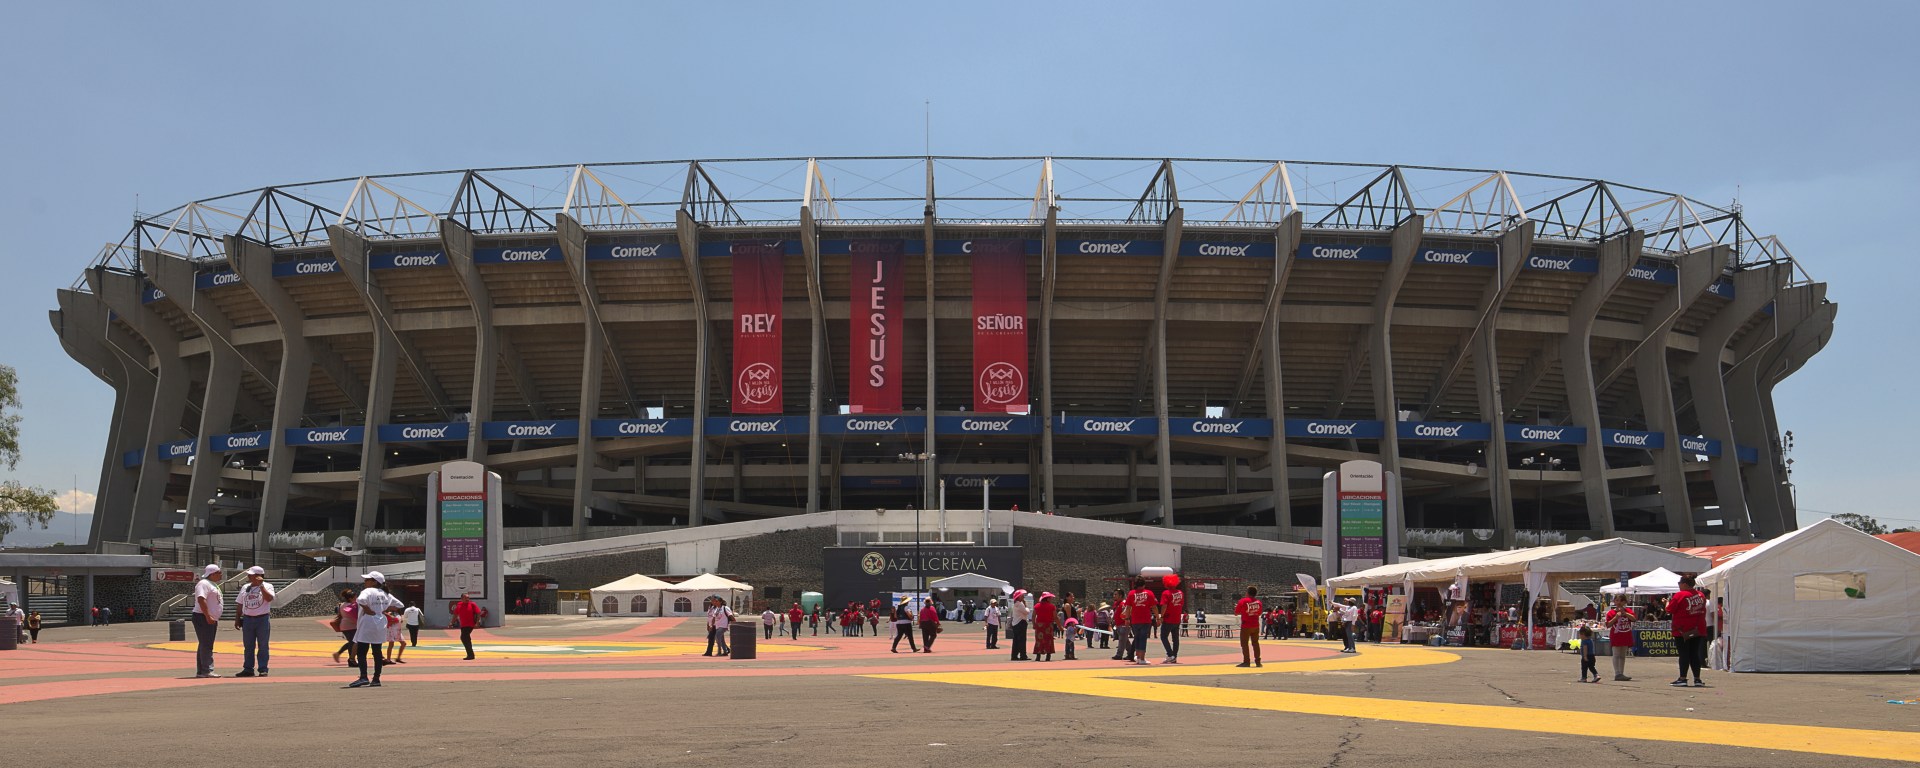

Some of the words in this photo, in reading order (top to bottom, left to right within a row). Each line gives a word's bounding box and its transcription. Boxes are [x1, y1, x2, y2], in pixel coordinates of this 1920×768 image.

[611, 244, 661, 258] Comex
[1079, 241, 1131, 254] Comex
[1199, 243, 1251, 256] Comex
[1312, 246, 1363, 259] Comex
[393, 252, 440, 266] Comex
[502, 248, 551, 261] Comex
[1424, 250, 1473, 264] Comex
[296, 260, 337, 274] Comex
[1530, 256, 1574, 270] Comex
[213, 273, 240, 285] Come
[741, 313, 776, 333] REY
[869, 260, 885, 387] JESÚS
[977, 313, 1023, 330] SEÑOR
[741, 382, 774, 405] Jesús
[982, 382, 1018, 404] Jesús
[507, 423, 556, 436] Comex
[618, 420, 668, 434] Comex
[730, 419, 781, 432] Comex
[846, 418, 898, 431] Comex
[961, 418, 1013, 431] Comex
[1083, 419, 1135, 432] Comex
[1192, 421, 1243, 434] Comex
[1307, 422, 1357, 435] Comex
[1415, 424, 1463, 437] Comex
[307, 428, 349, 442] Comex
[402, 426, 449, 439] Comex
[1521, 428, 1564, 440] Comex
[1613, 432, 1649, 446] Comex
[227, 434, 262, 448] Comex
[1682, 438, 1708, 452] Comex
[170, 442, 194, 456] Comex
[887, 558, 987, 571] AZULCREMA
